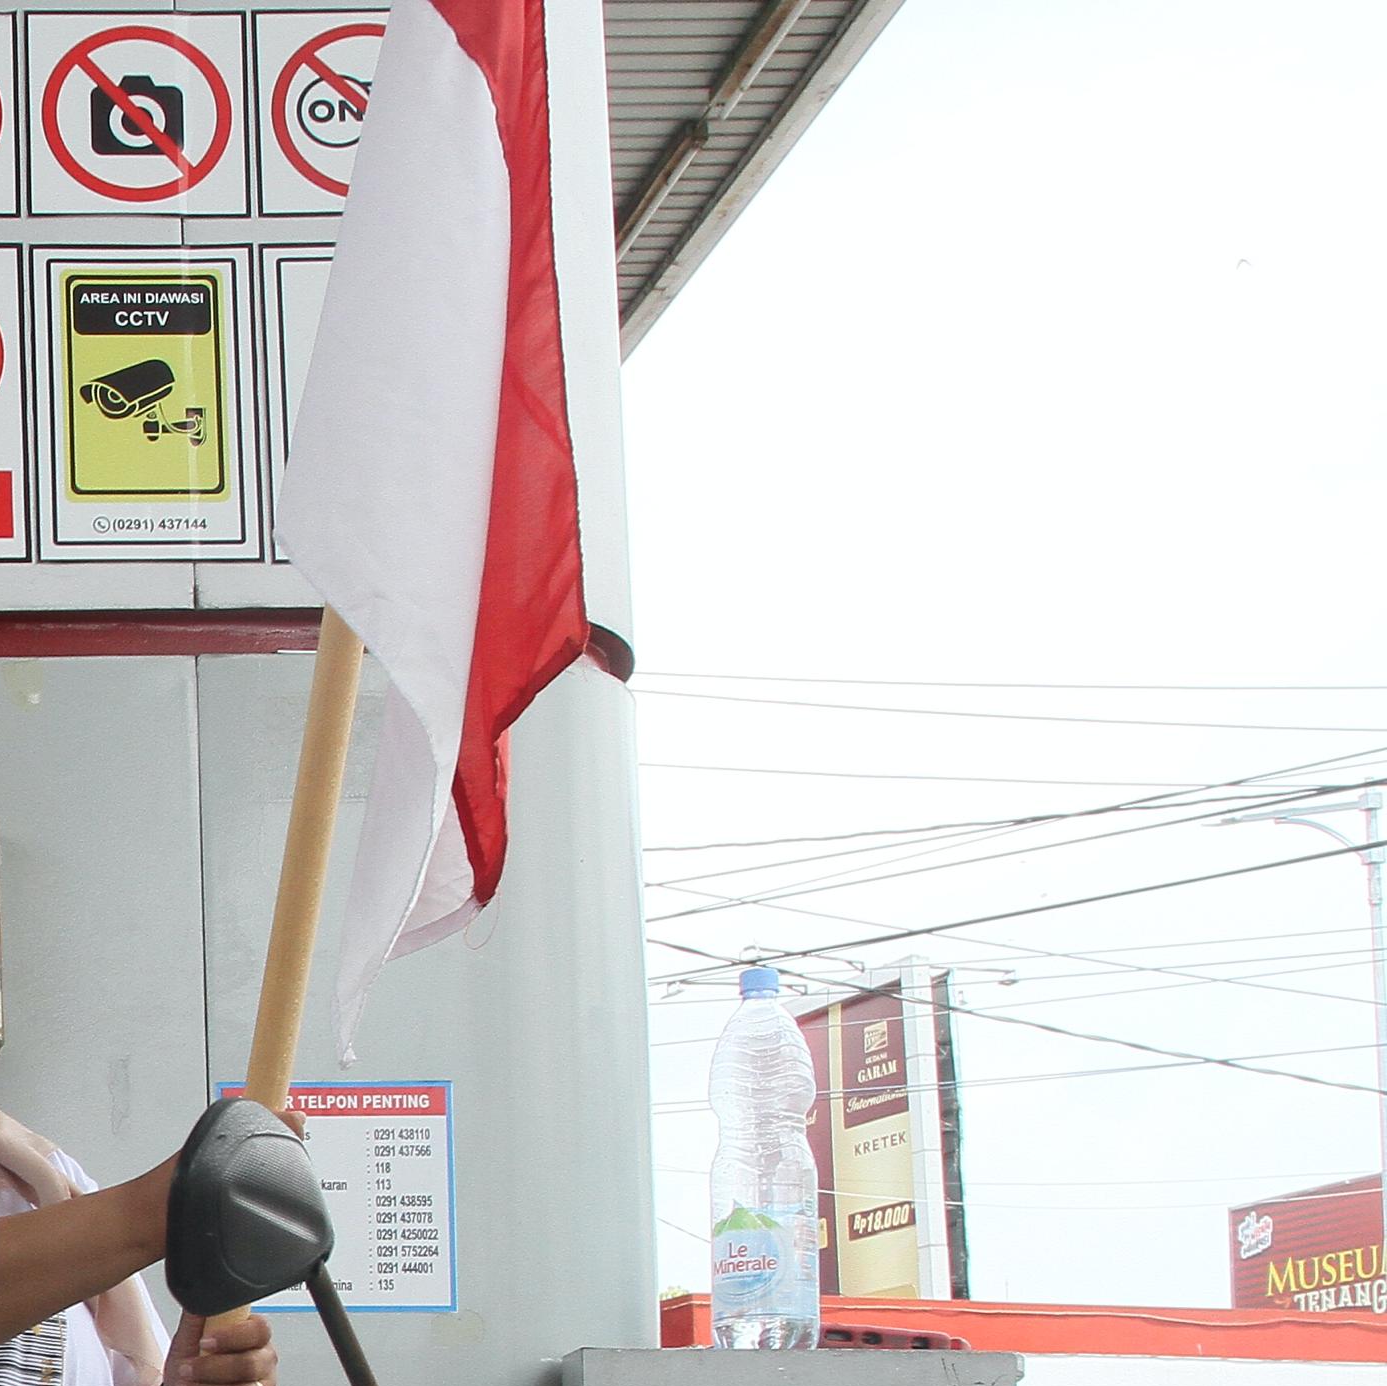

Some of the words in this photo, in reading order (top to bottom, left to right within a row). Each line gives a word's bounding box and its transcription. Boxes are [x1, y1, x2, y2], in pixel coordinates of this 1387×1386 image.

[80, 293, 120, 304] AREA
[124, 293, 141, 304] INI
[145, 293, 204, 304] DIAWASI
[115, 311, 169, 326] CCTV
[112, 517, 155, 533] (0291)
[158, 517, 208, 531] 437144
[857, 1060, 897, 1083] GARAM
[300, 1096, 358, 1109] TELPON
[363, 1095, 430, 1108] PENTING
[374, 1129, 396, 1140] 0291
[398, 1129, 430, 1140] 438110
[854, 1131, 907, 1156] KRETEK
[374, 1146, 396, 1157] 0291
[398, 1146, 431, 1156] 437566
[375, 1163, 391, 1173] 118
[375, 1179, 391, 1190] 113
[375, 1196, 397, 1207] 0291
[399, 1196, 432, 1206] 438595
[376, 1213, 398, 1223] 0291
[400, 1213, 433, 1223] 437078
[376, 1230, 398, 1240] 0291
[401, 1229, 439, 1239] 4250022
[377, 1246, 398, 1257] 0291
[401, 1246, 439, 1256] 5752264
[728, 1242, 747, 1258] Le
[377, 1263, 399, 1273] 0291
[402, 1263, 434, 1273] 444001
[714, 1255, 777, 1274] Minerale
[1265, 1245, 1387, 1297] MUSEU
[378, 1280, 395, 1290] 135
